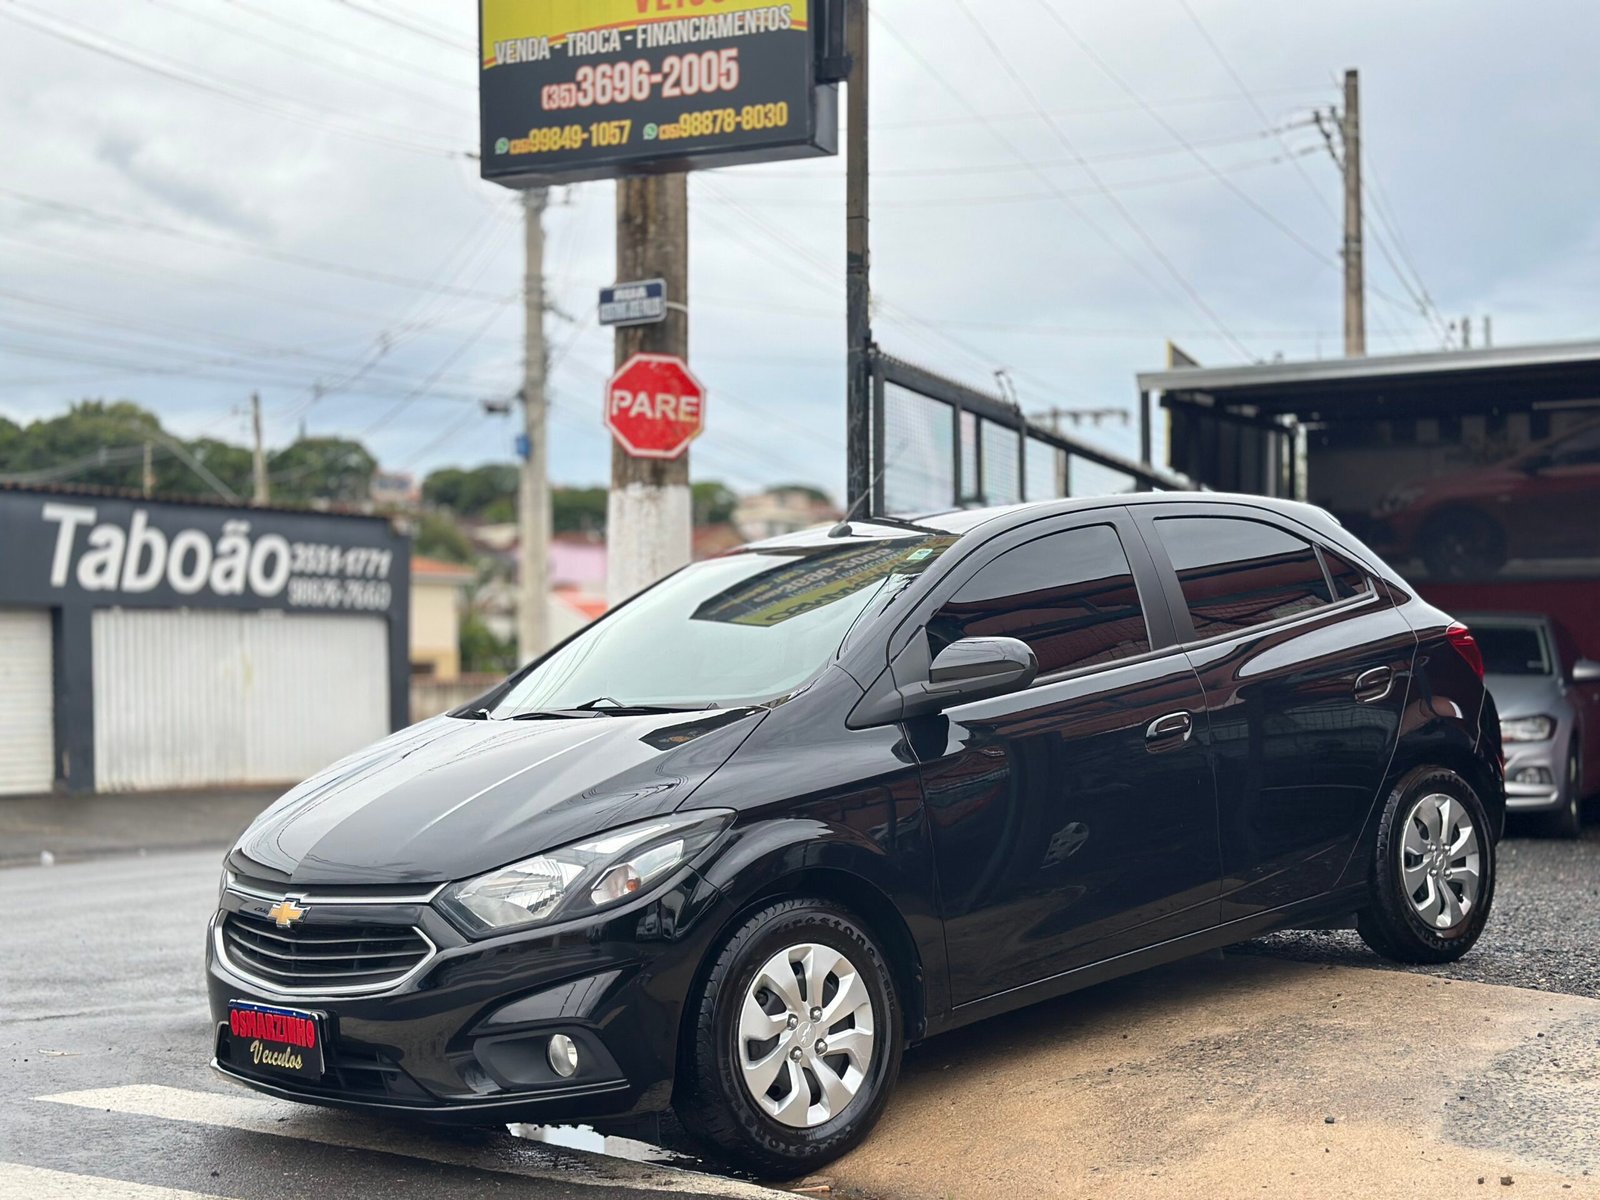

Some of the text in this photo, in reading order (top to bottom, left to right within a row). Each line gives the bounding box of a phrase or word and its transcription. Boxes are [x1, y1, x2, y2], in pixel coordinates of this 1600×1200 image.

[494, 36, 551, 65] VENDA
[567, 28, 621, 57] TROCA
[636, 5, 792, 49] FINANCIAMENTOS
[612, 390, 699, 422] PARE
[42, 502, 292, 598] Taboão
[230, 1009, 316, 1049] OSMARZINHO
